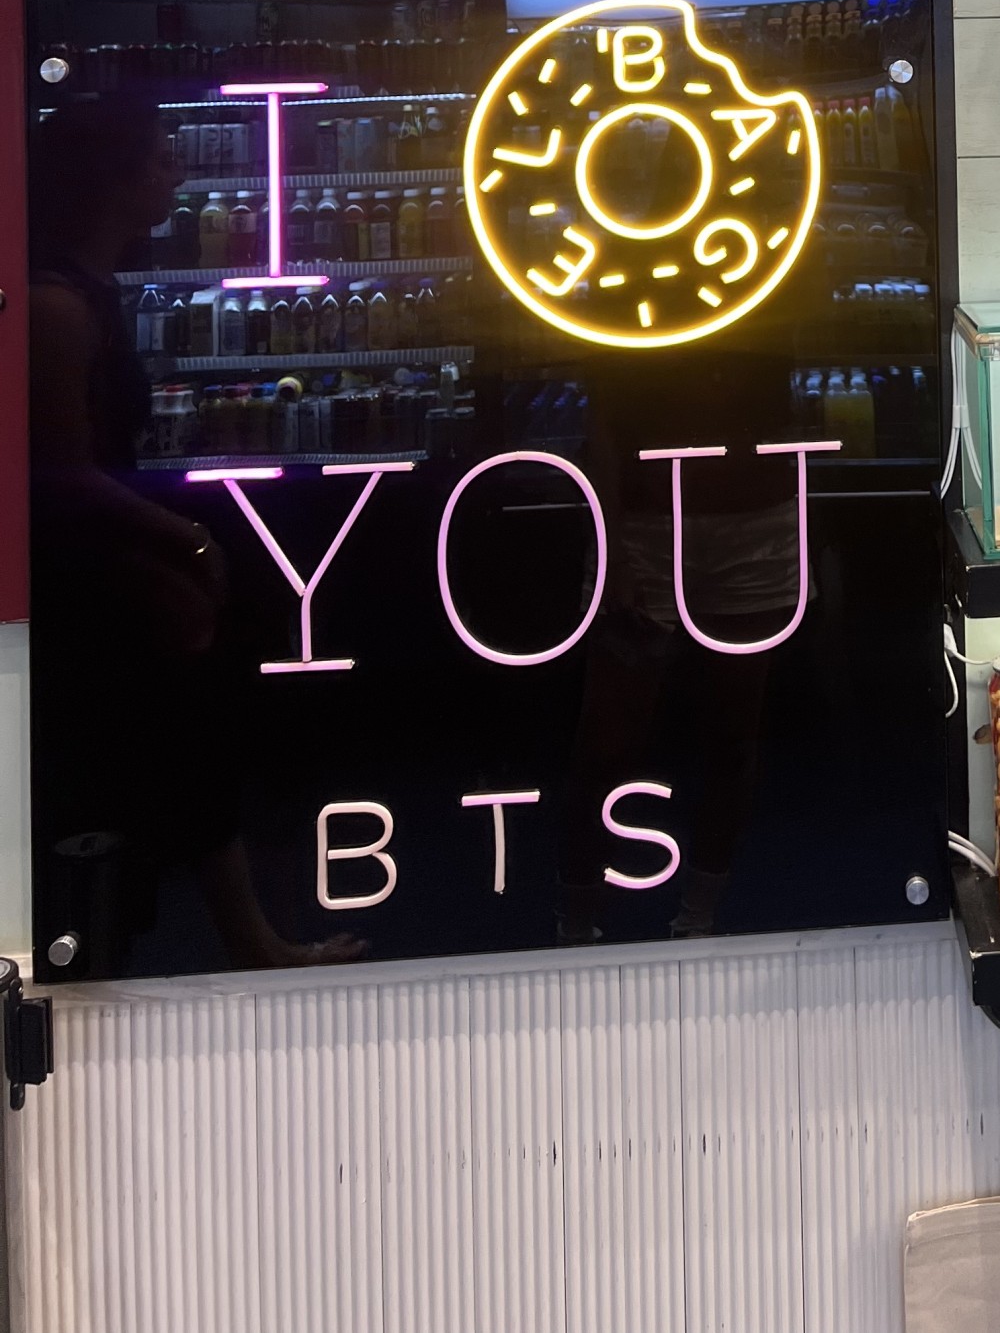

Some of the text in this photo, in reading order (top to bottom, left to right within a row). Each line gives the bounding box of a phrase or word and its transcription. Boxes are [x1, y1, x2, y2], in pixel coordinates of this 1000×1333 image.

[219, 25, 778, 298] I BAGEL
[185, 439, 843, 674] YOU
